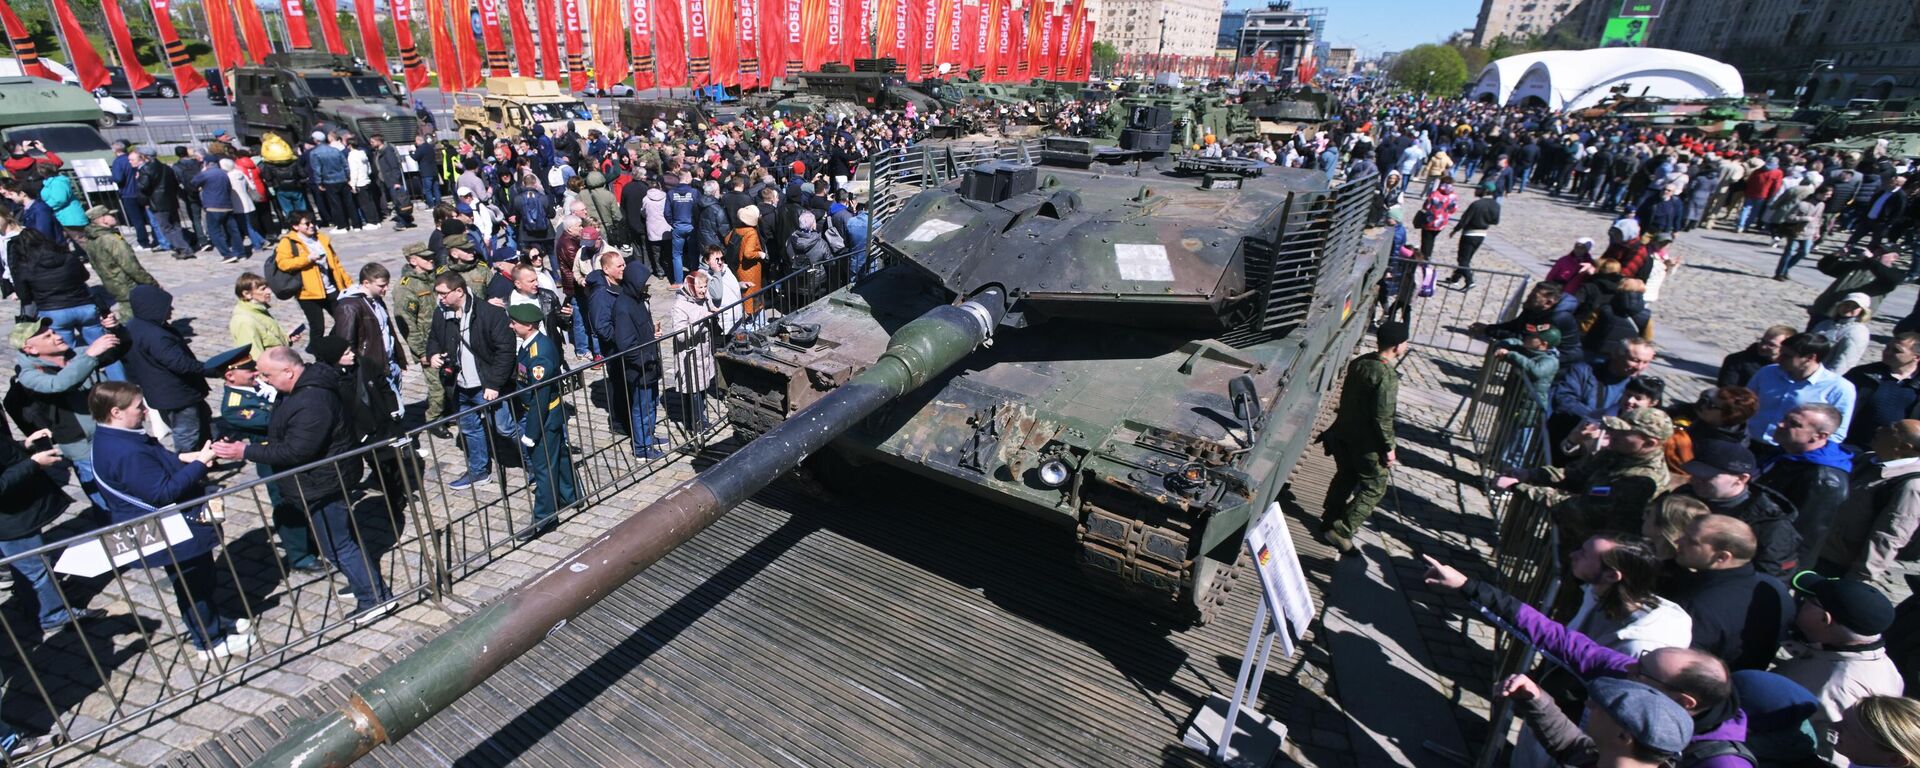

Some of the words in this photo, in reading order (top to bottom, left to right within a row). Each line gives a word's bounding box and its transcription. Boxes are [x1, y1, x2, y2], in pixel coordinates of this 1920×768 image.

[567, 0, 579, 31] ПО
[691, 0, 704, 37] ПОБ
[789, 0, 801, 43] ПОБЕ
[978, 3, 990, 53] ПОБЕДА!
[999, 6, 1010, 54] ПОБЕДА!
[1041, 11, 1053, 56] ПОБЕДА!
[1059, 13, 1071, 56] ПОБЕДА!
